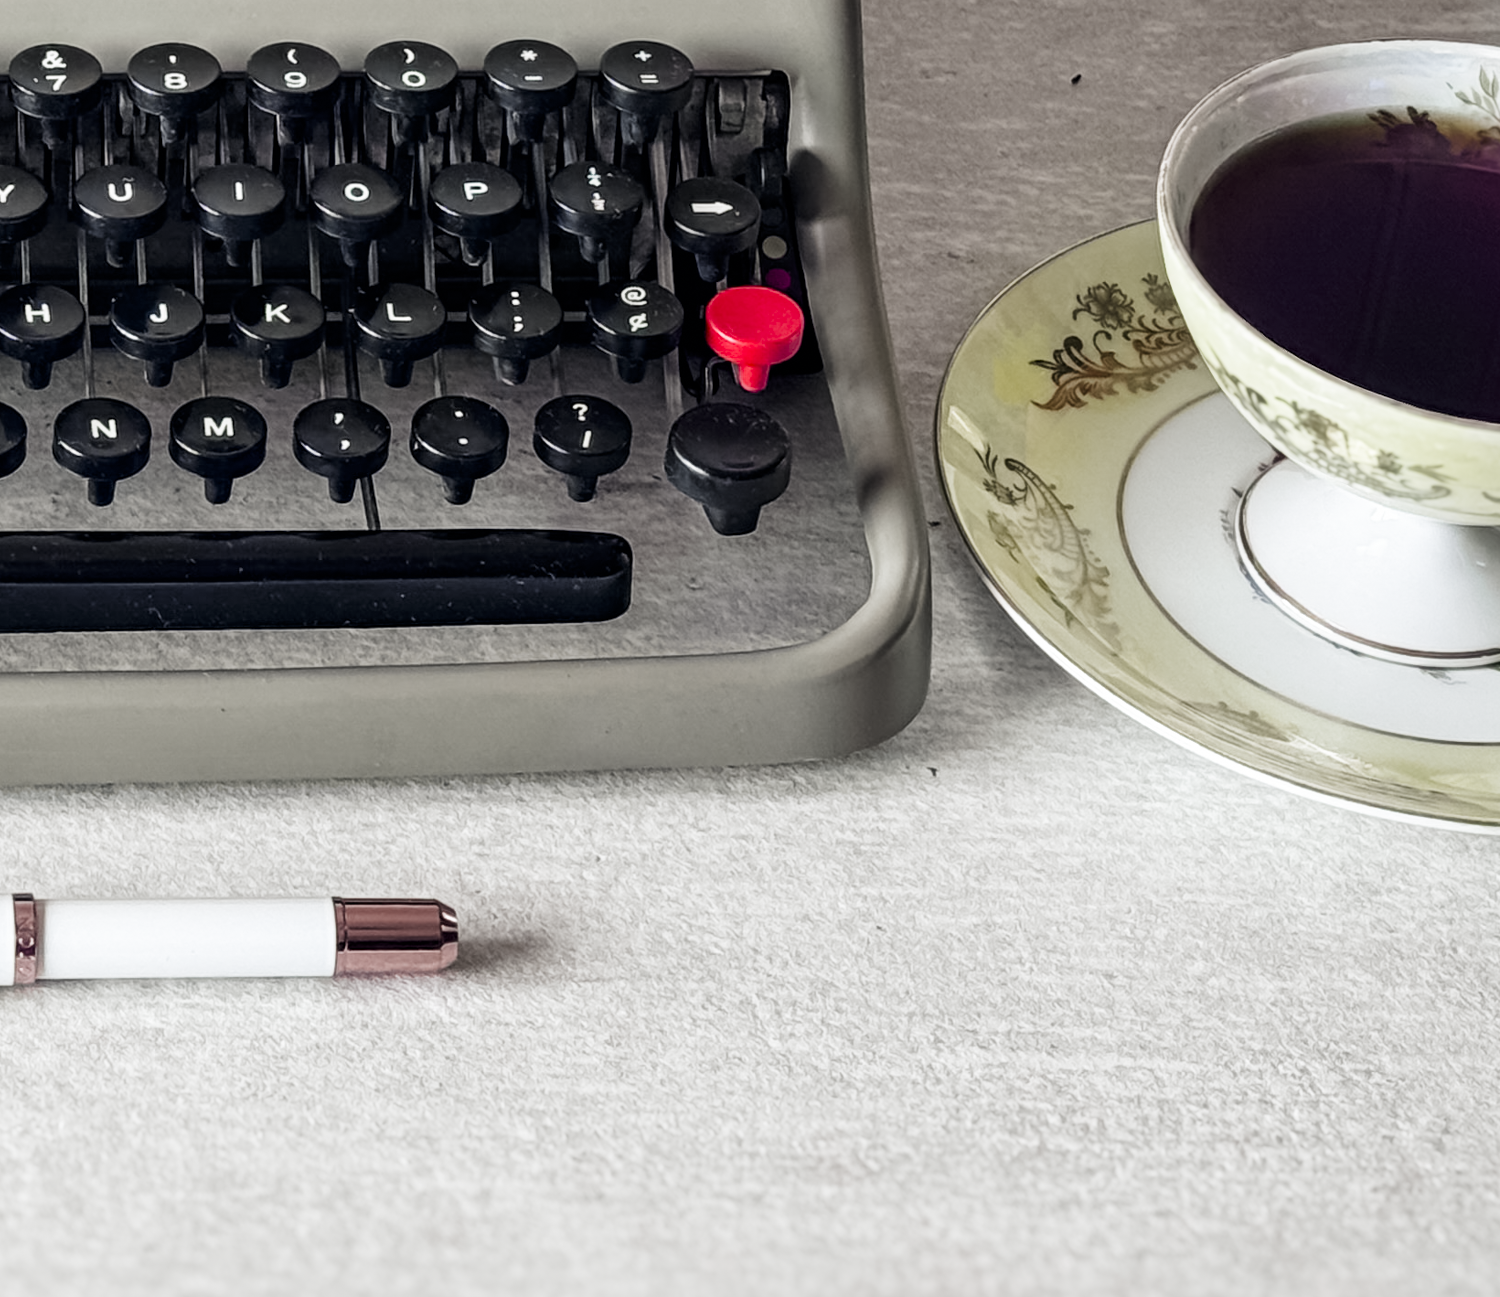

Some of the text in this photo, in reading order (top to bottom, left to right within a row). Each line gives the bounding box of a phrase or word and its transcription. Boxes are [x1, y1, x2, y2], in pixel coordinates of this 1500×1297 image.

[41, 50, 67, 69] &
[51, 74, 68, 92] 7
[164, 72, 188, 90] 8
[283, 71, 307, 89] 9
[107, 182, 133, 202] U
[344, 182, 370, 202] O
[463, 181, 489, 201] P
[620, 286, 648, 306] @
[24, 303, 51, 324] H
[149, 303, 169, 323] J
[265, 303, 291, 324] K
[386, 302, 413, 322] L
[572, 403, 588, 422] ?
[90, 418, 118, 439] N
[203, 417, 234, 437] M
